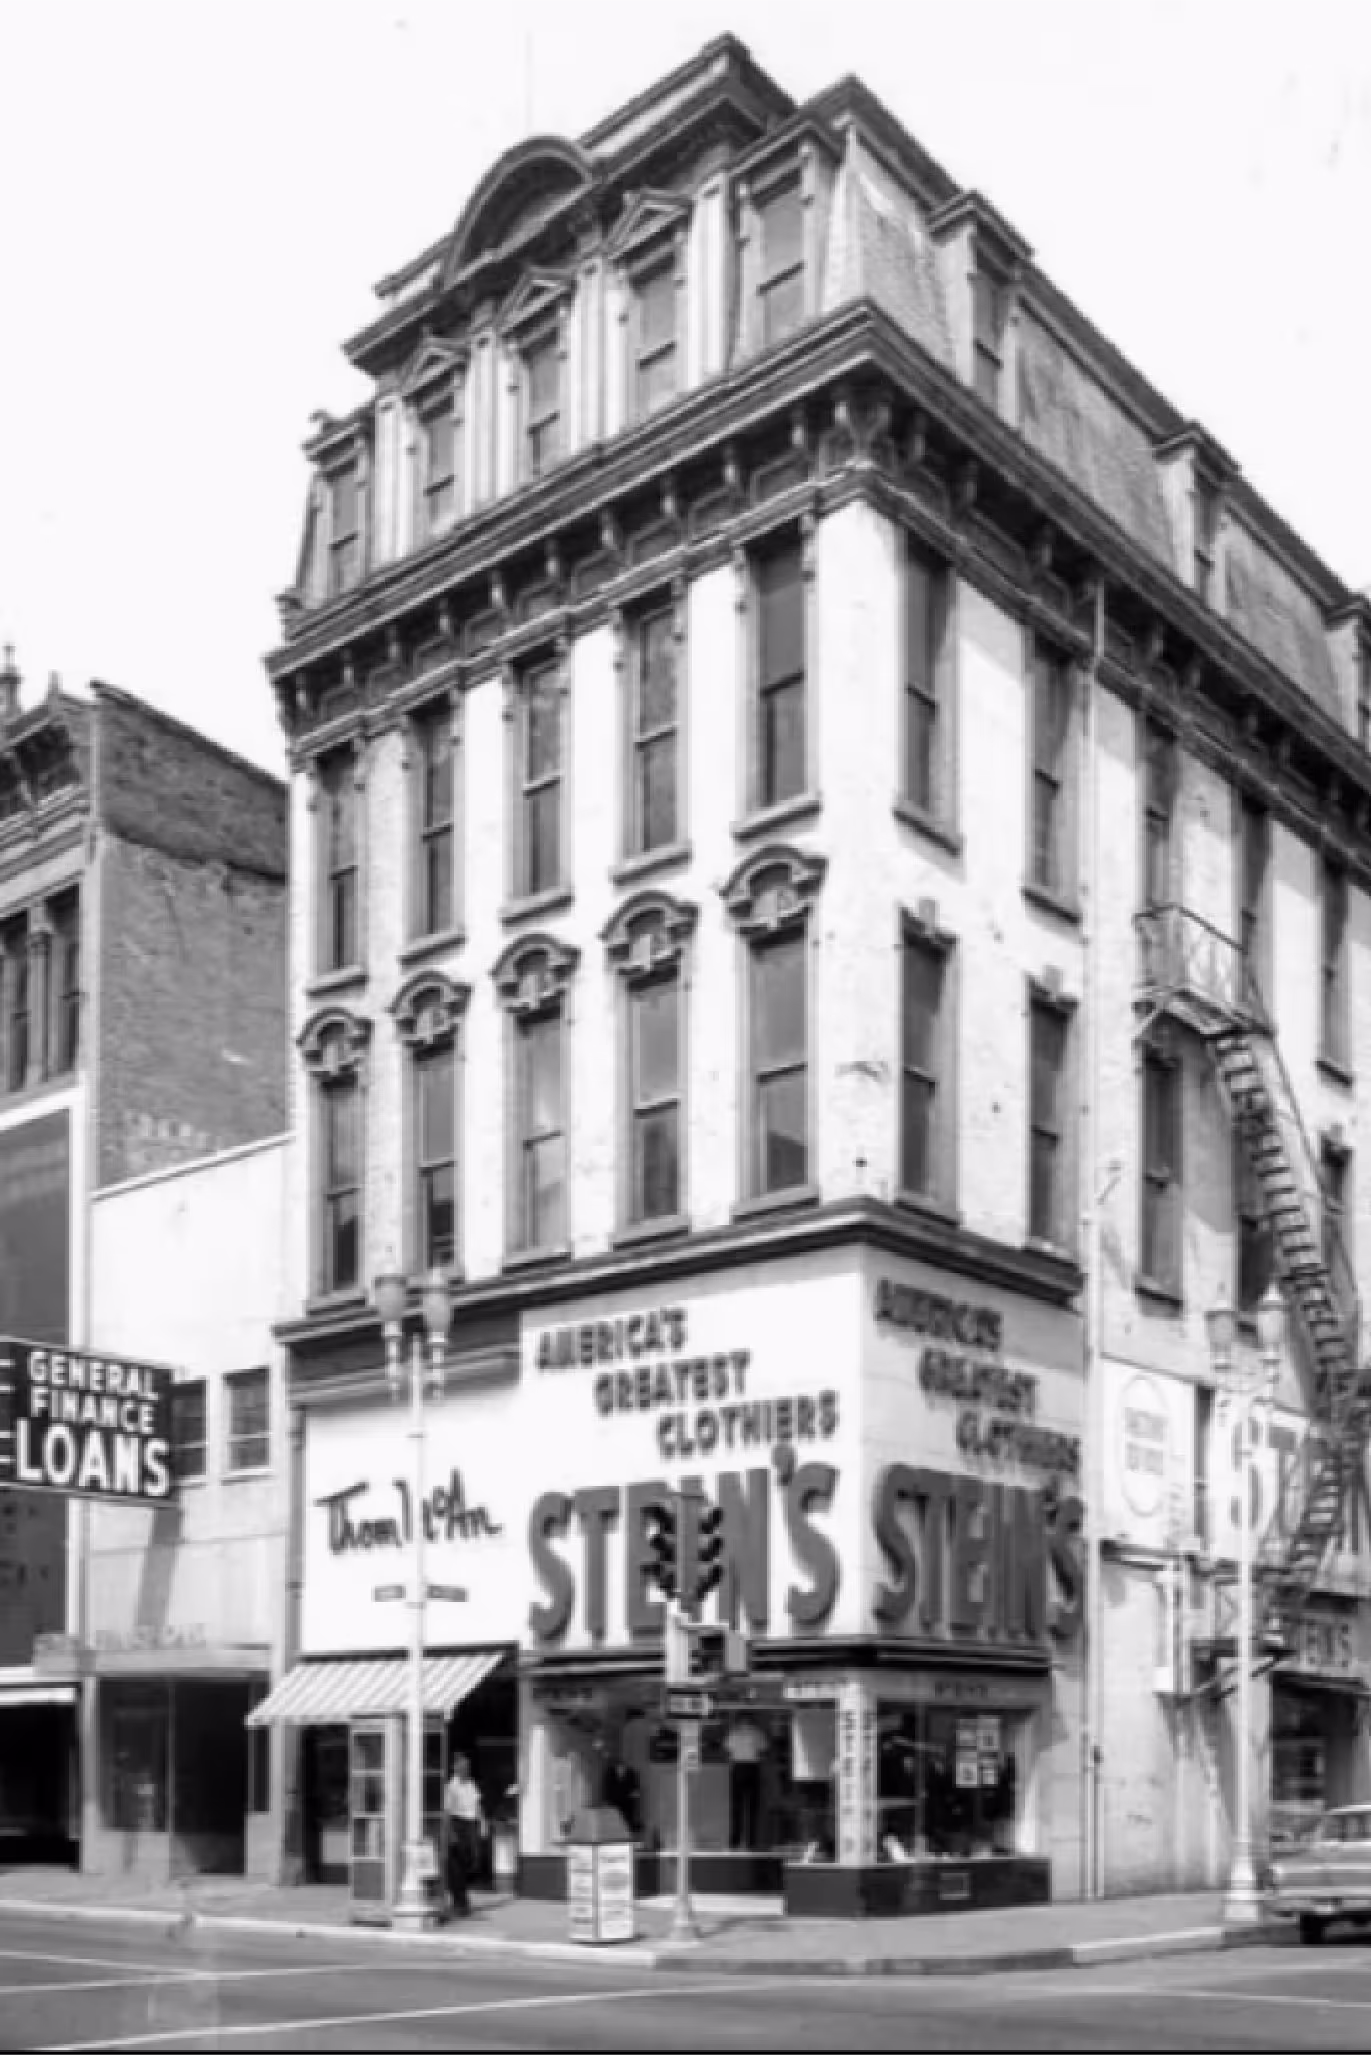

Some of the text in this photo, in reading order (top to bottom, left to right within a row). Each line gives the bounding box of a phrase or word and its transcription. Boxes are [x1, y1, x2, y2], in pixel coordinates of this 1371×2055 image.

[537, 1307, 685, 1372] AMERICA'S
[28, 1351, 160, 1401] GENERAL
[595, 1350, 750, 1416] GREATEST
[30, 1385, 155, 1434] FINANCE
[657, 1389, 838, 1457] CLOTHIERS
[16, 1416, 170, 1497] LOANS
[870, 1463, 1084, 1648] STEIN'S
